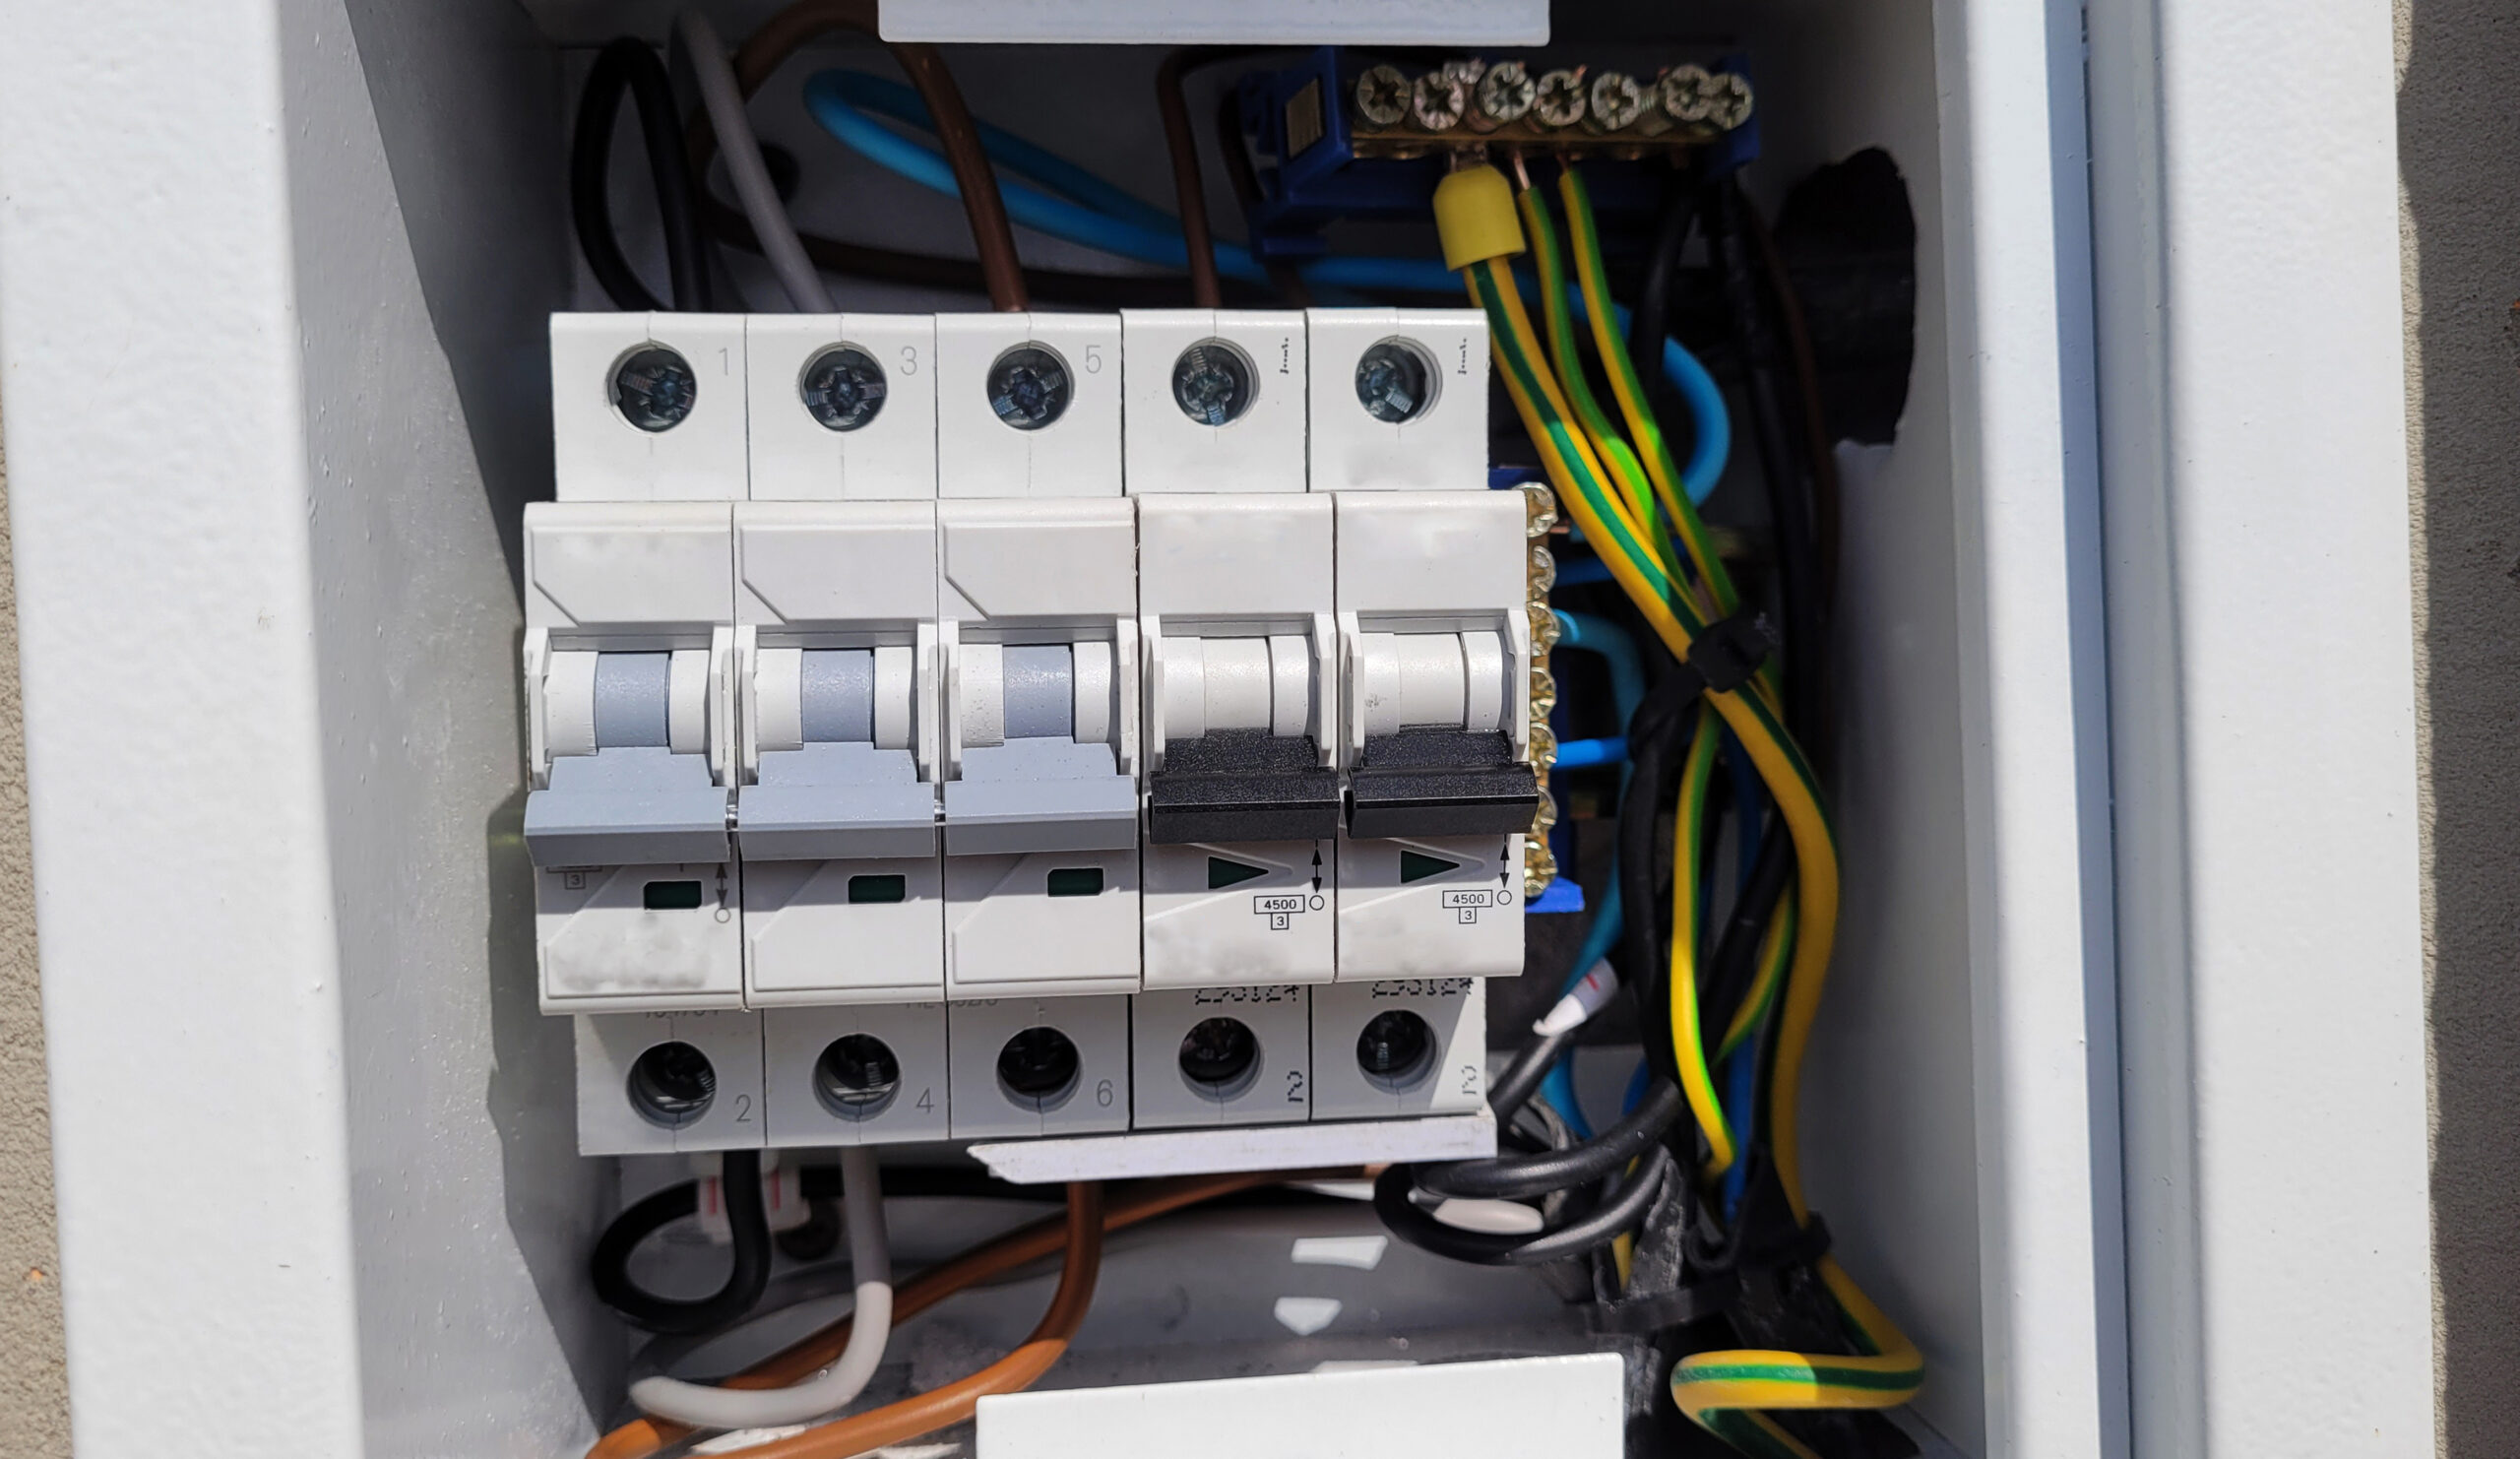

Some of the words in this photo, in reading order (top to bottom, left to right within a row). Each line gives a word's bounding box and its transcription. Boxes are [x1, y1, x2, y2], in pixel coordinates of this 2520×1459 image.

[719, 347, 729, 376] 1
[900, 345, 917, 376] 3
[1085, 345, 1102, 374] 5
[570, 873, 581, 886] 3
[1264, 899, 1297, 911] 4500
[1452, 893, 1484, 905] 4500
[1276, 916, 1285, 926] 3
[1464, 910, 1473, 920] 3
[1097, 1079, 1113, 1108] 6
[1287, 1070, 1303, 1103] 2
[1461, 1064, 1477, 1095] 2
[735, 1094, 752, 1122] 2
[914, 1087, 935, 1114] 4
